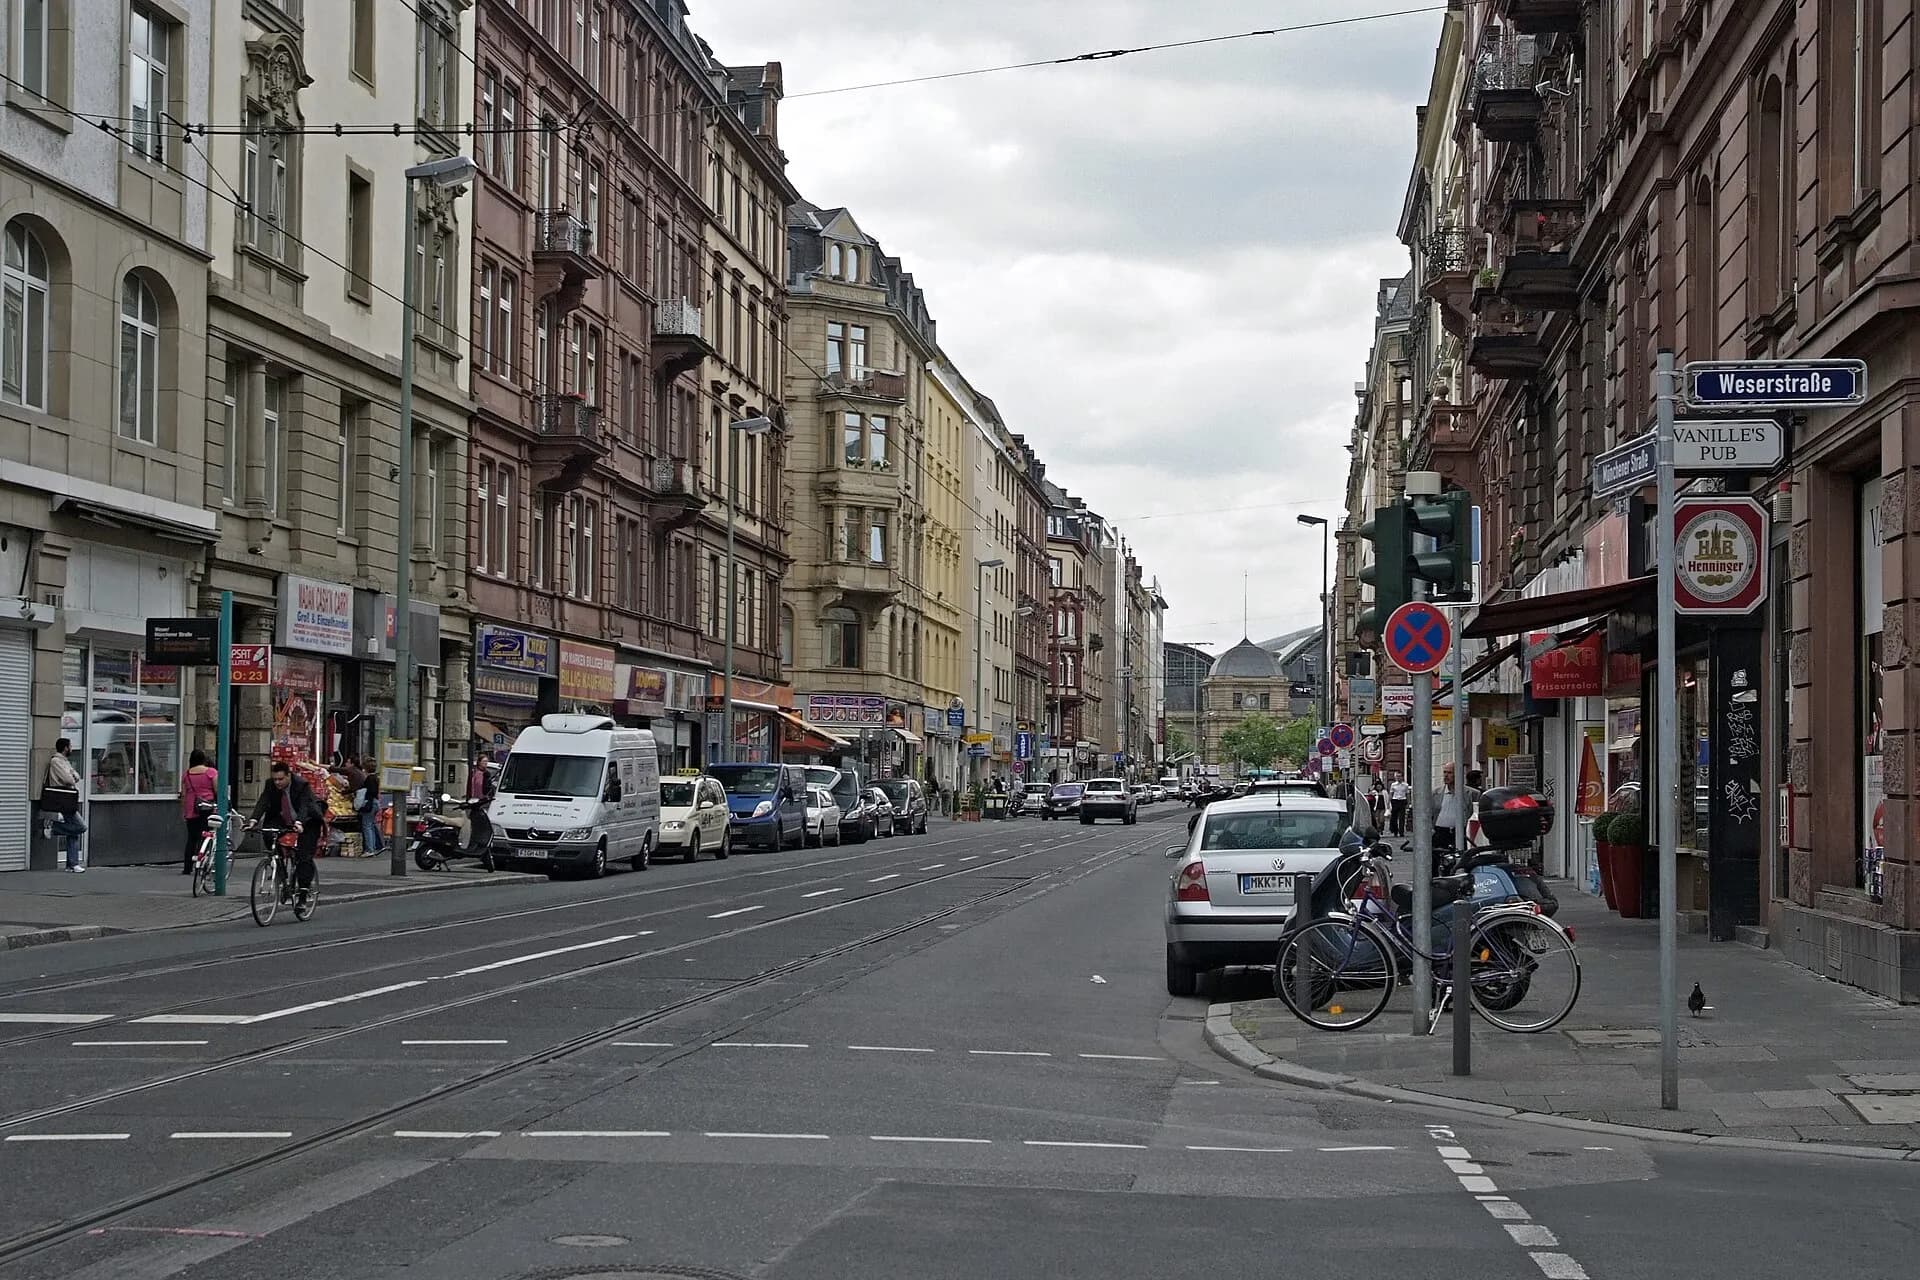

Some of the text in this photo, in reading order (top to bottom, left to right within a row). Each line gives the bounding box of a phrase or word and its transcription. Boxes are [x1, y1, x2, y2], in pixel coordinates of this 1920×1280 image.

[1719, 372, 1832, 394] Weserstraße
[1673, 428, 1765, 443] VANILLE'S
[1700, 446, 1737, 461] PUB
[1602, 448, 1648, 485] Münchener Straße
[1688, 560, 1744, 573] Henninger
[231, 648, 252, 660] PSAT
[1317, 728, 1326, 738] P
[1251, 876, 1292, 889] MKK FN
